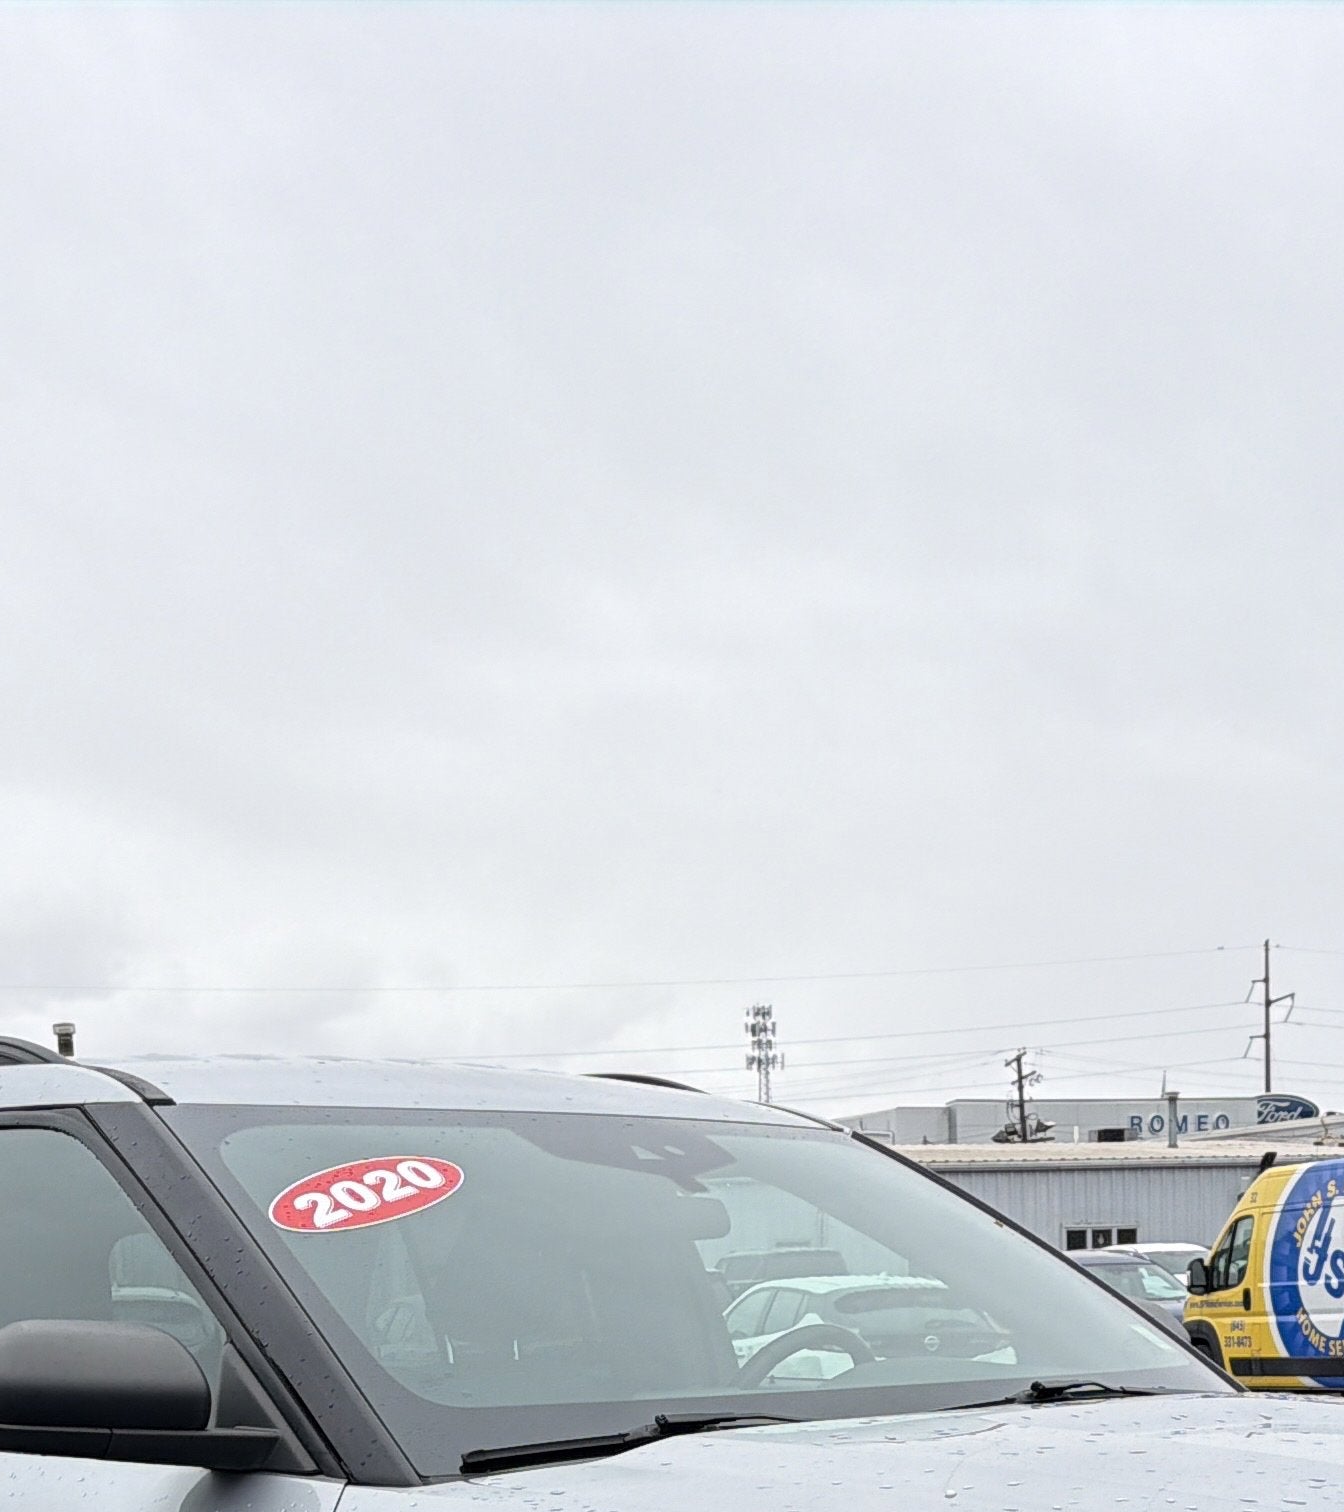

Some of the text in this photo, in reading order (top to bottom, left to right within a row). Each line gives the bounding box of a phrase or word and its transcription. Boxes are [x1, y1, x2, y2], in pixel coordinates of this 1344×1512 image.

[1130, 1113, 1230, 1132] ROMEO
[1256, 1101, 1303, 1123] Ford
[293, 1160, 446, 1228] 2020
[1293, 1190, 1324, 1248] JOHN
[1326, 1179, 1340, 1198] S.
[1296, 1306, 1328, 1353] HOME
